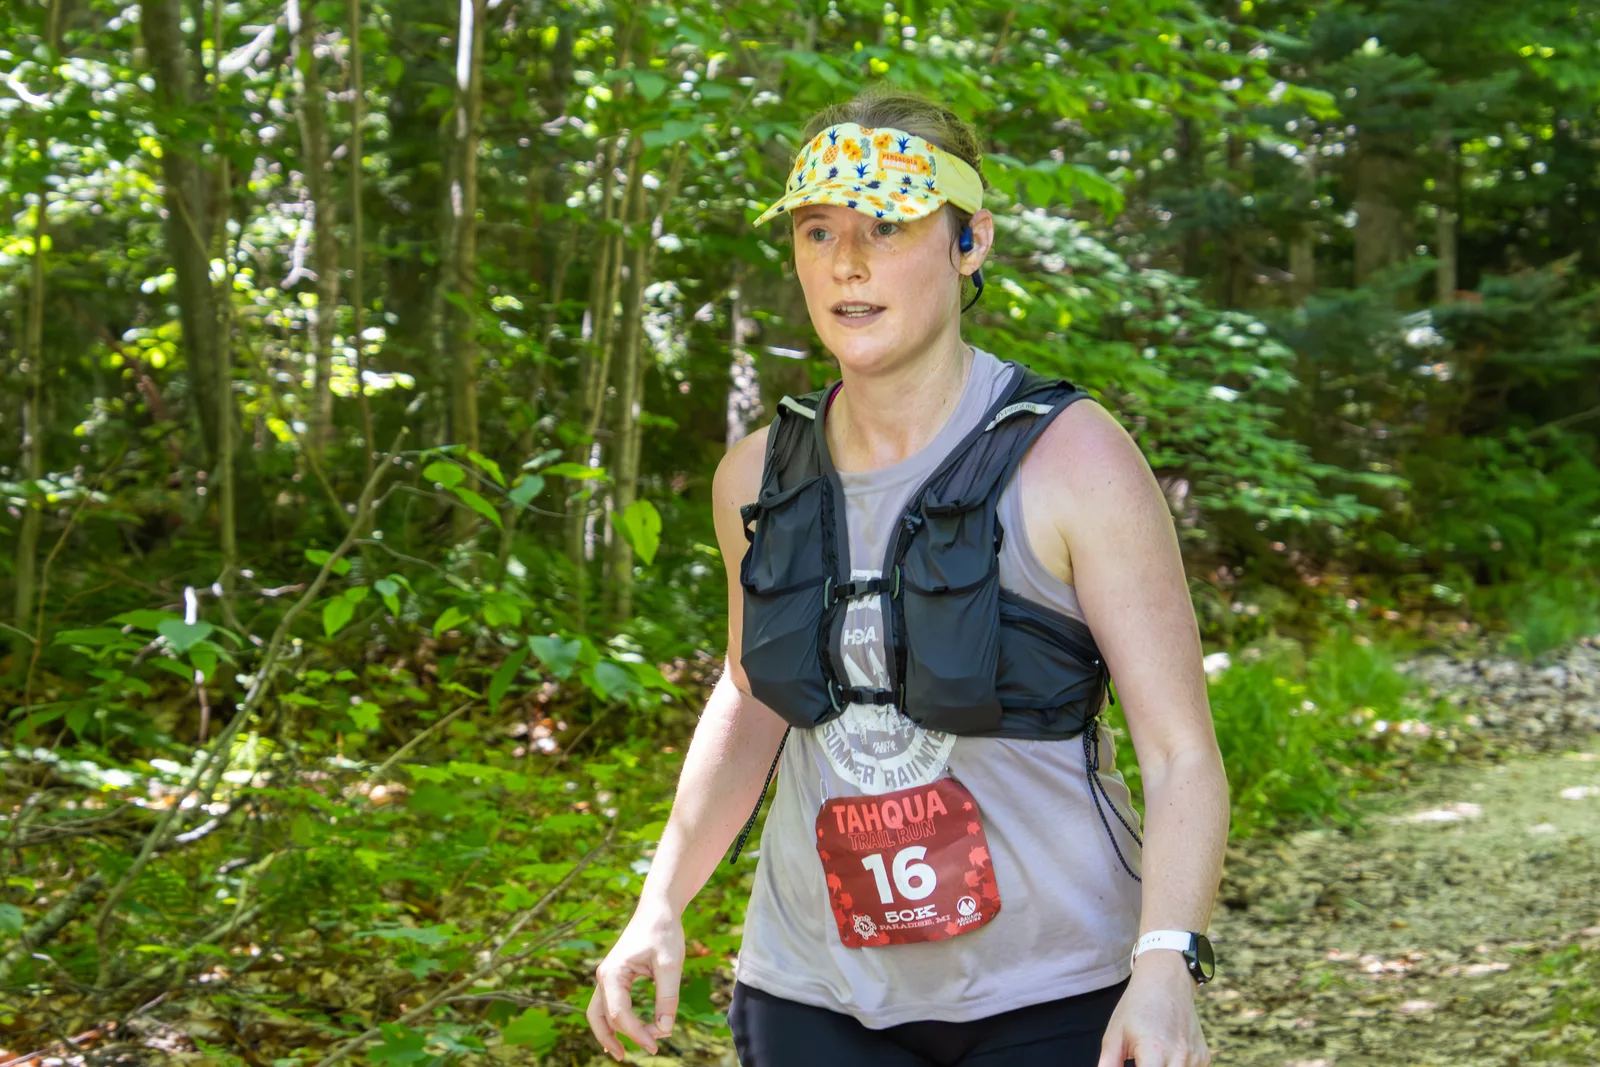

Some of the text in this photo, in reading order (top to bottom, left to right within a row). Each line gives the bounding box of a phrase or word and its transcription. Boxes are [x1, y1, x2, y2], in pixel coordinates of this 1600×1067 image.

[832, 789, 948, 835] TAHQUA
[848, 819, 937, 851] TRAIL RUN
[861, 845, 937, 905] 16
[884, 904, 938, 923] 50K
